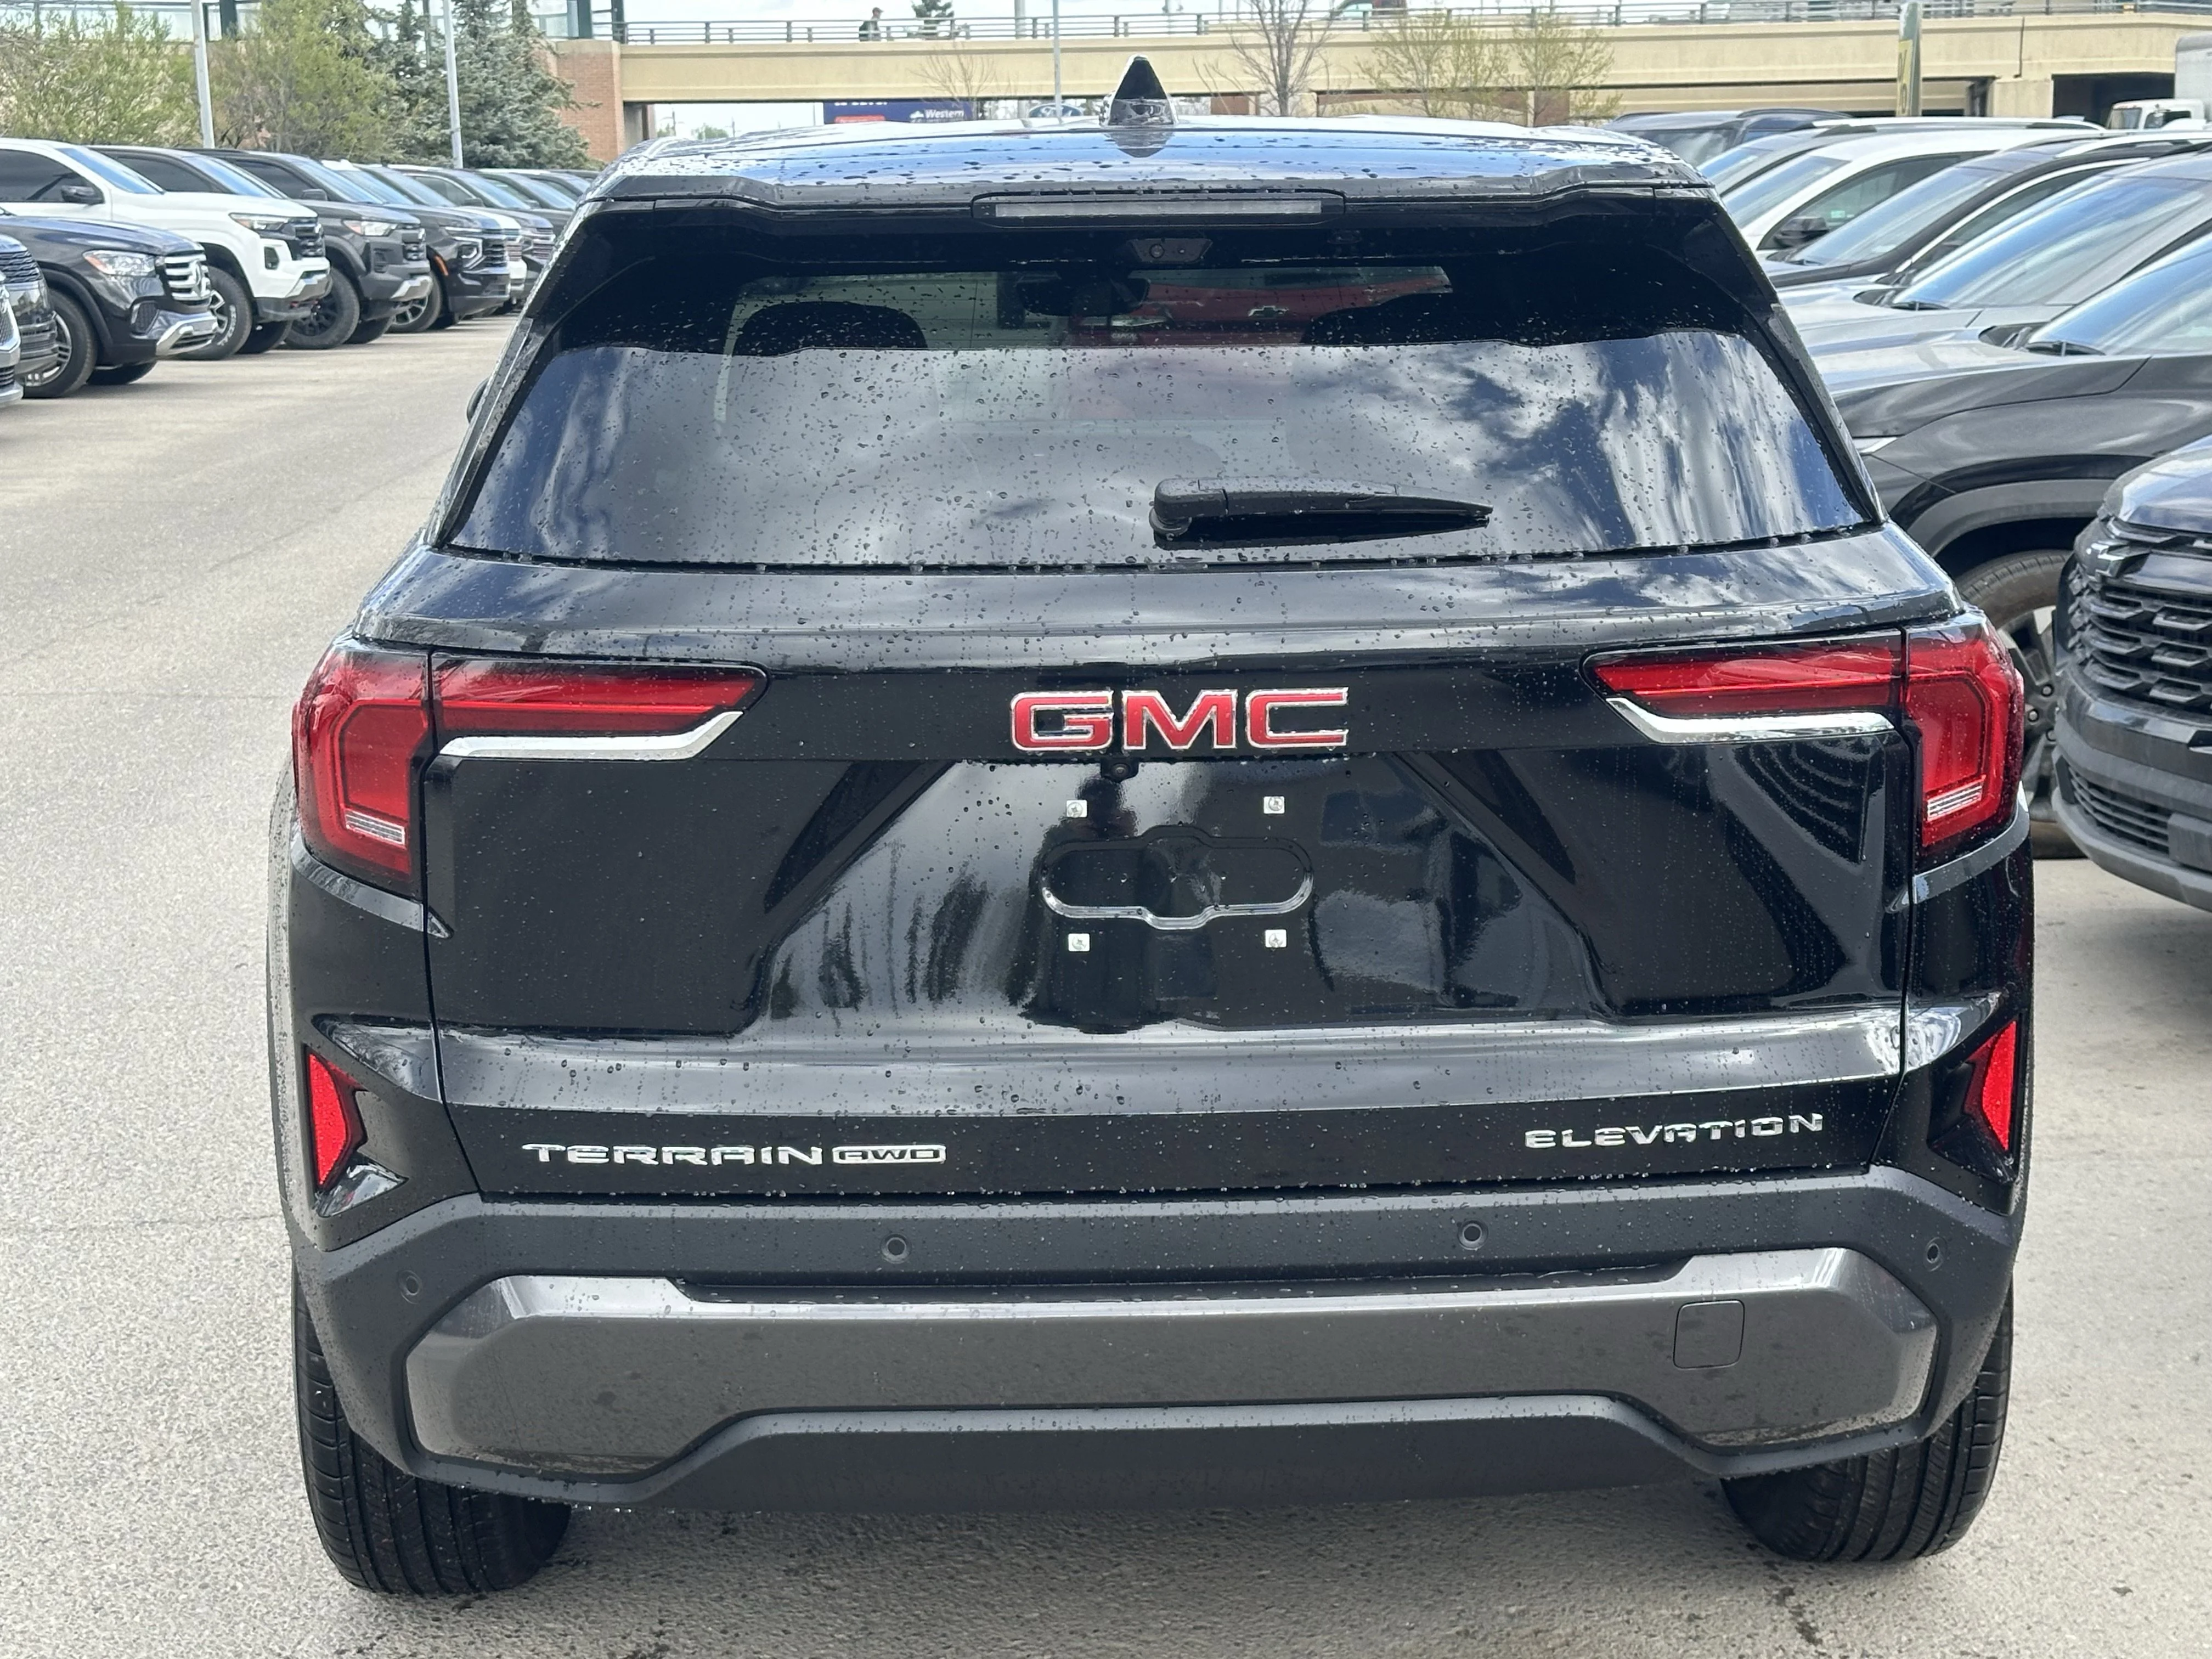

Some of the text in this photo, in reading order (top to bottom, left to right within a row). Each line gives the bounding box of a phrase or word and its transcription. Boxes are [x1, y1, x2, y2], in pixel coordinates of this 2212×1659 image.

[924, 109, 964, 119] Western
[1011, 688, 1348, 749] GMC
[1525, 1113, 1823, 1148] ELEVATION
[522, 1143, 943, 1165] TERRAIN AWD
